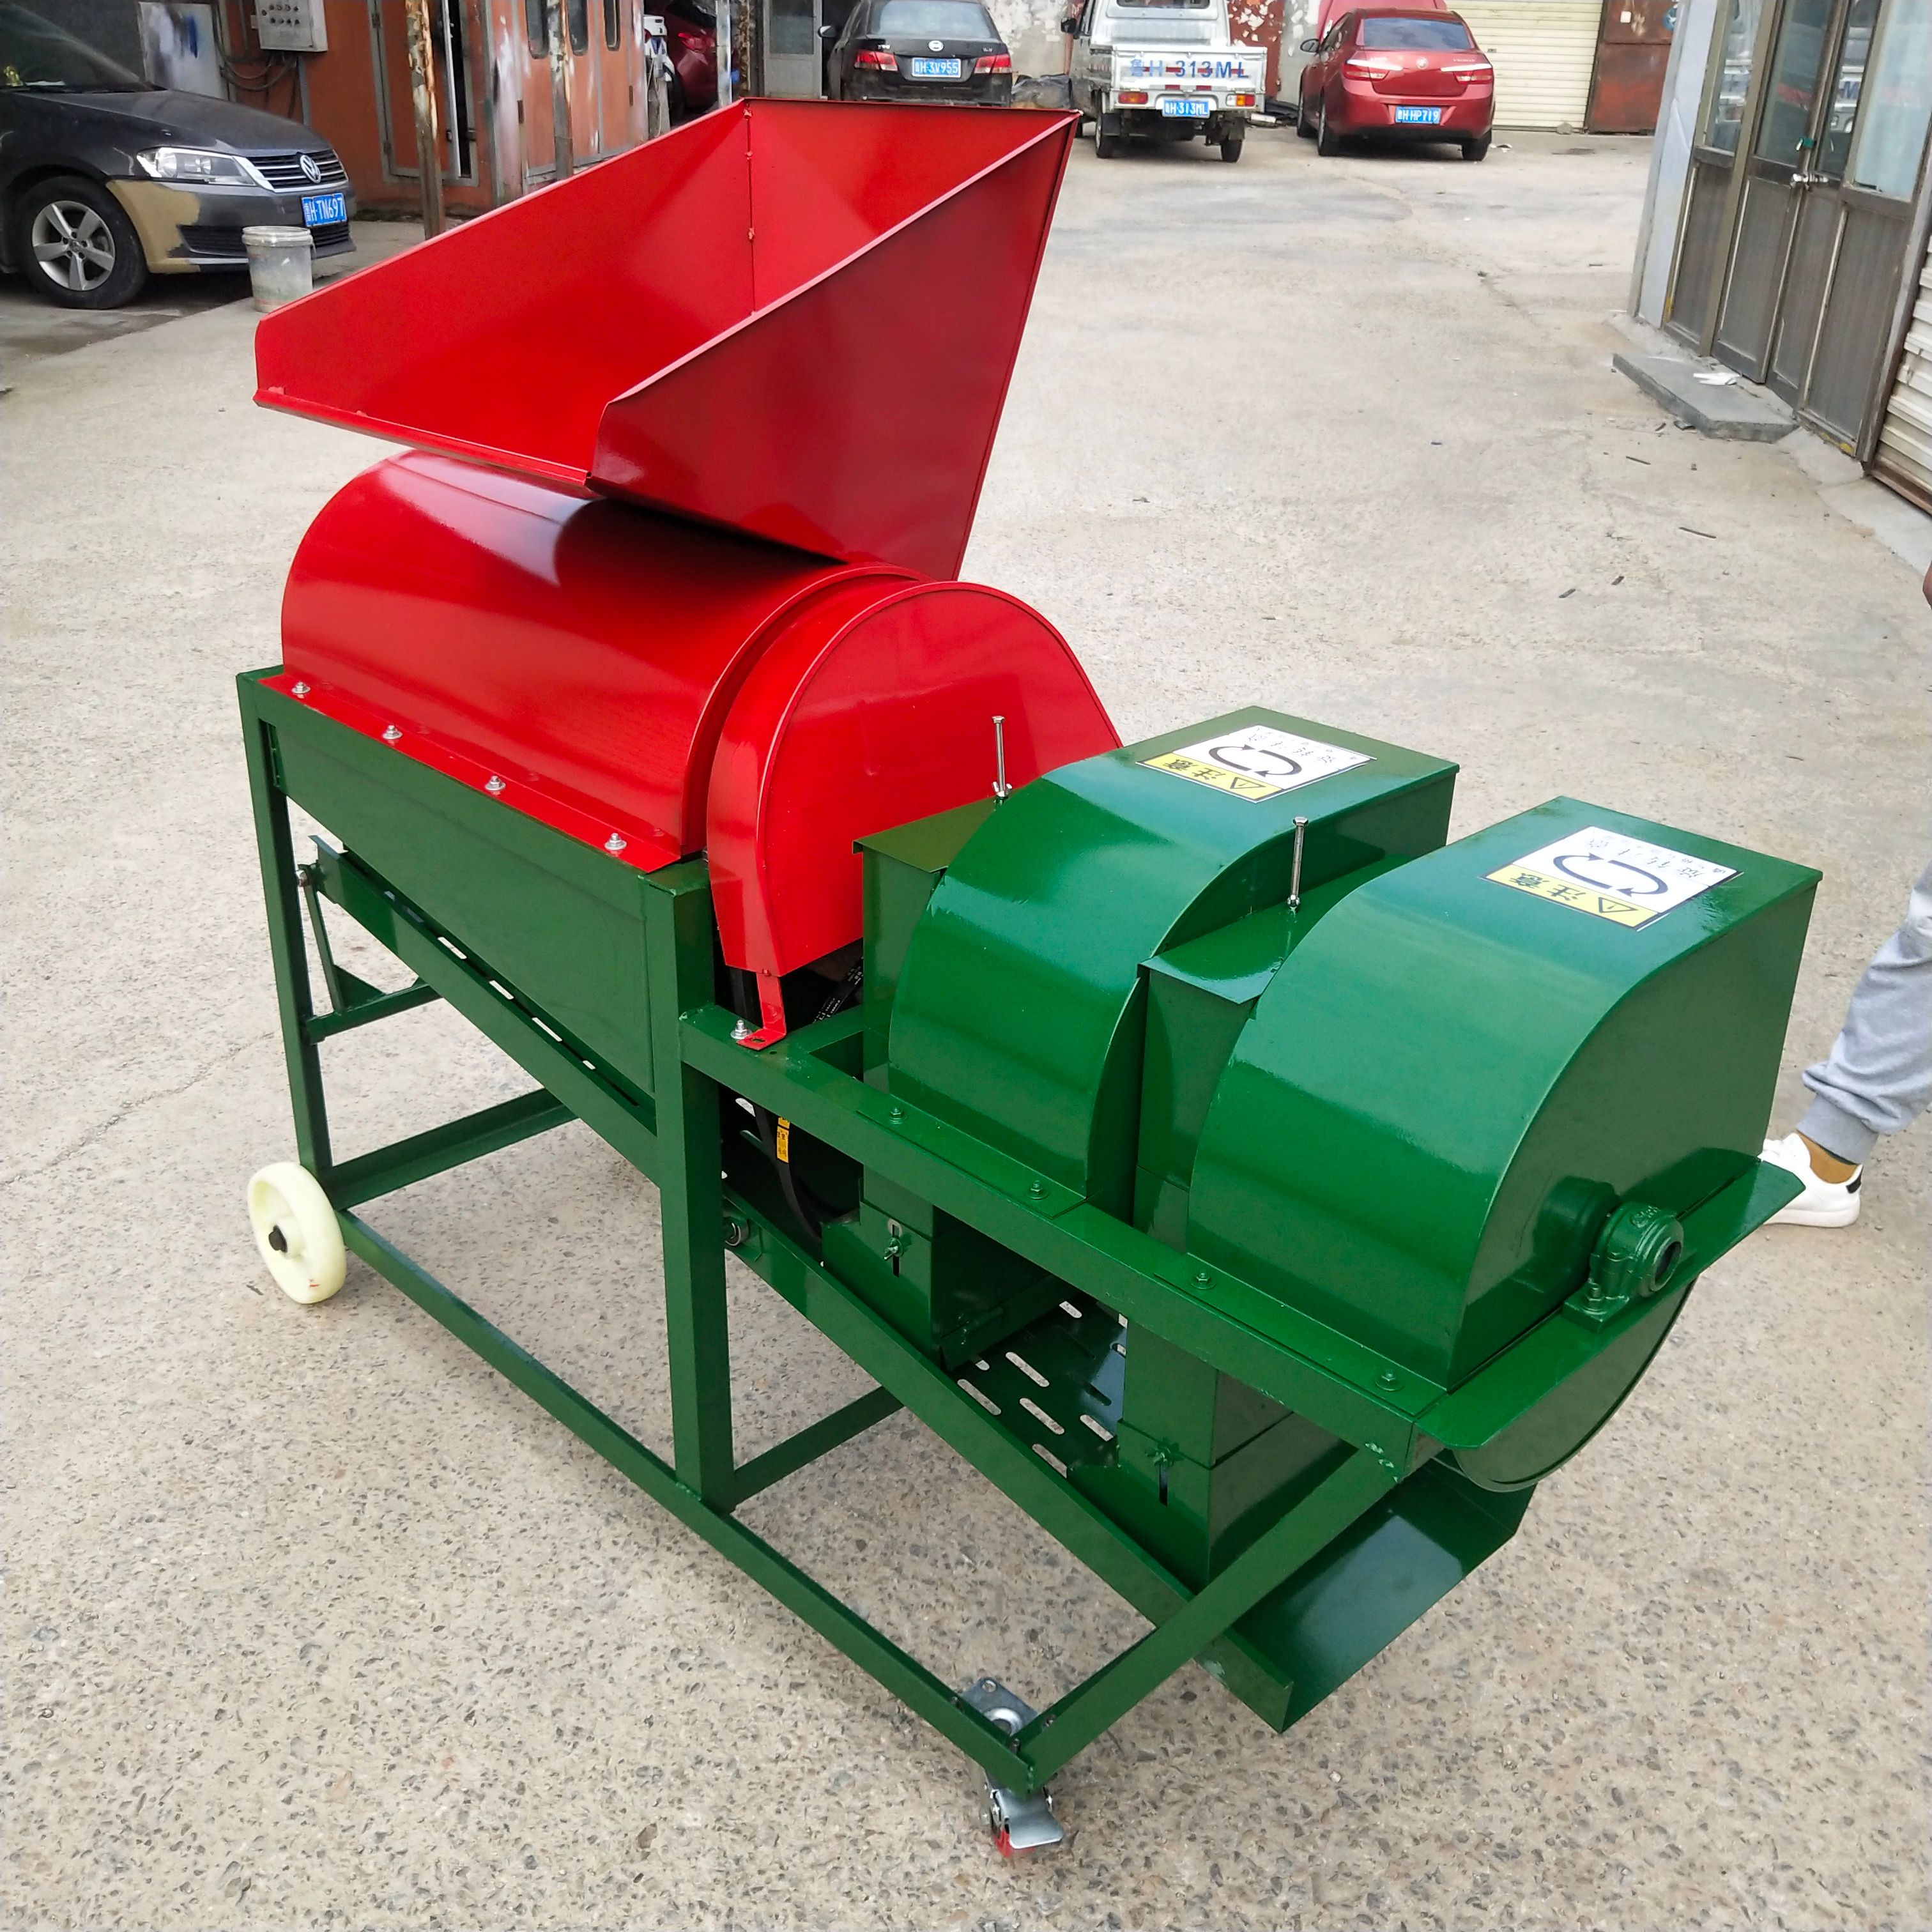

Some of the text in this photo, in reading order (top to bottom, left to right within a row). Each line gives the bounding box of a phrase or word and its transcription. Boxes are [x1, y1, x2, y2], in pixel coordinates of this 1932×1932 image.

[1175, 60, 1250, 79] 313ML
[1162, 758, 1226, 781] 注意
[1508, 872, 1586, 901] 注意
